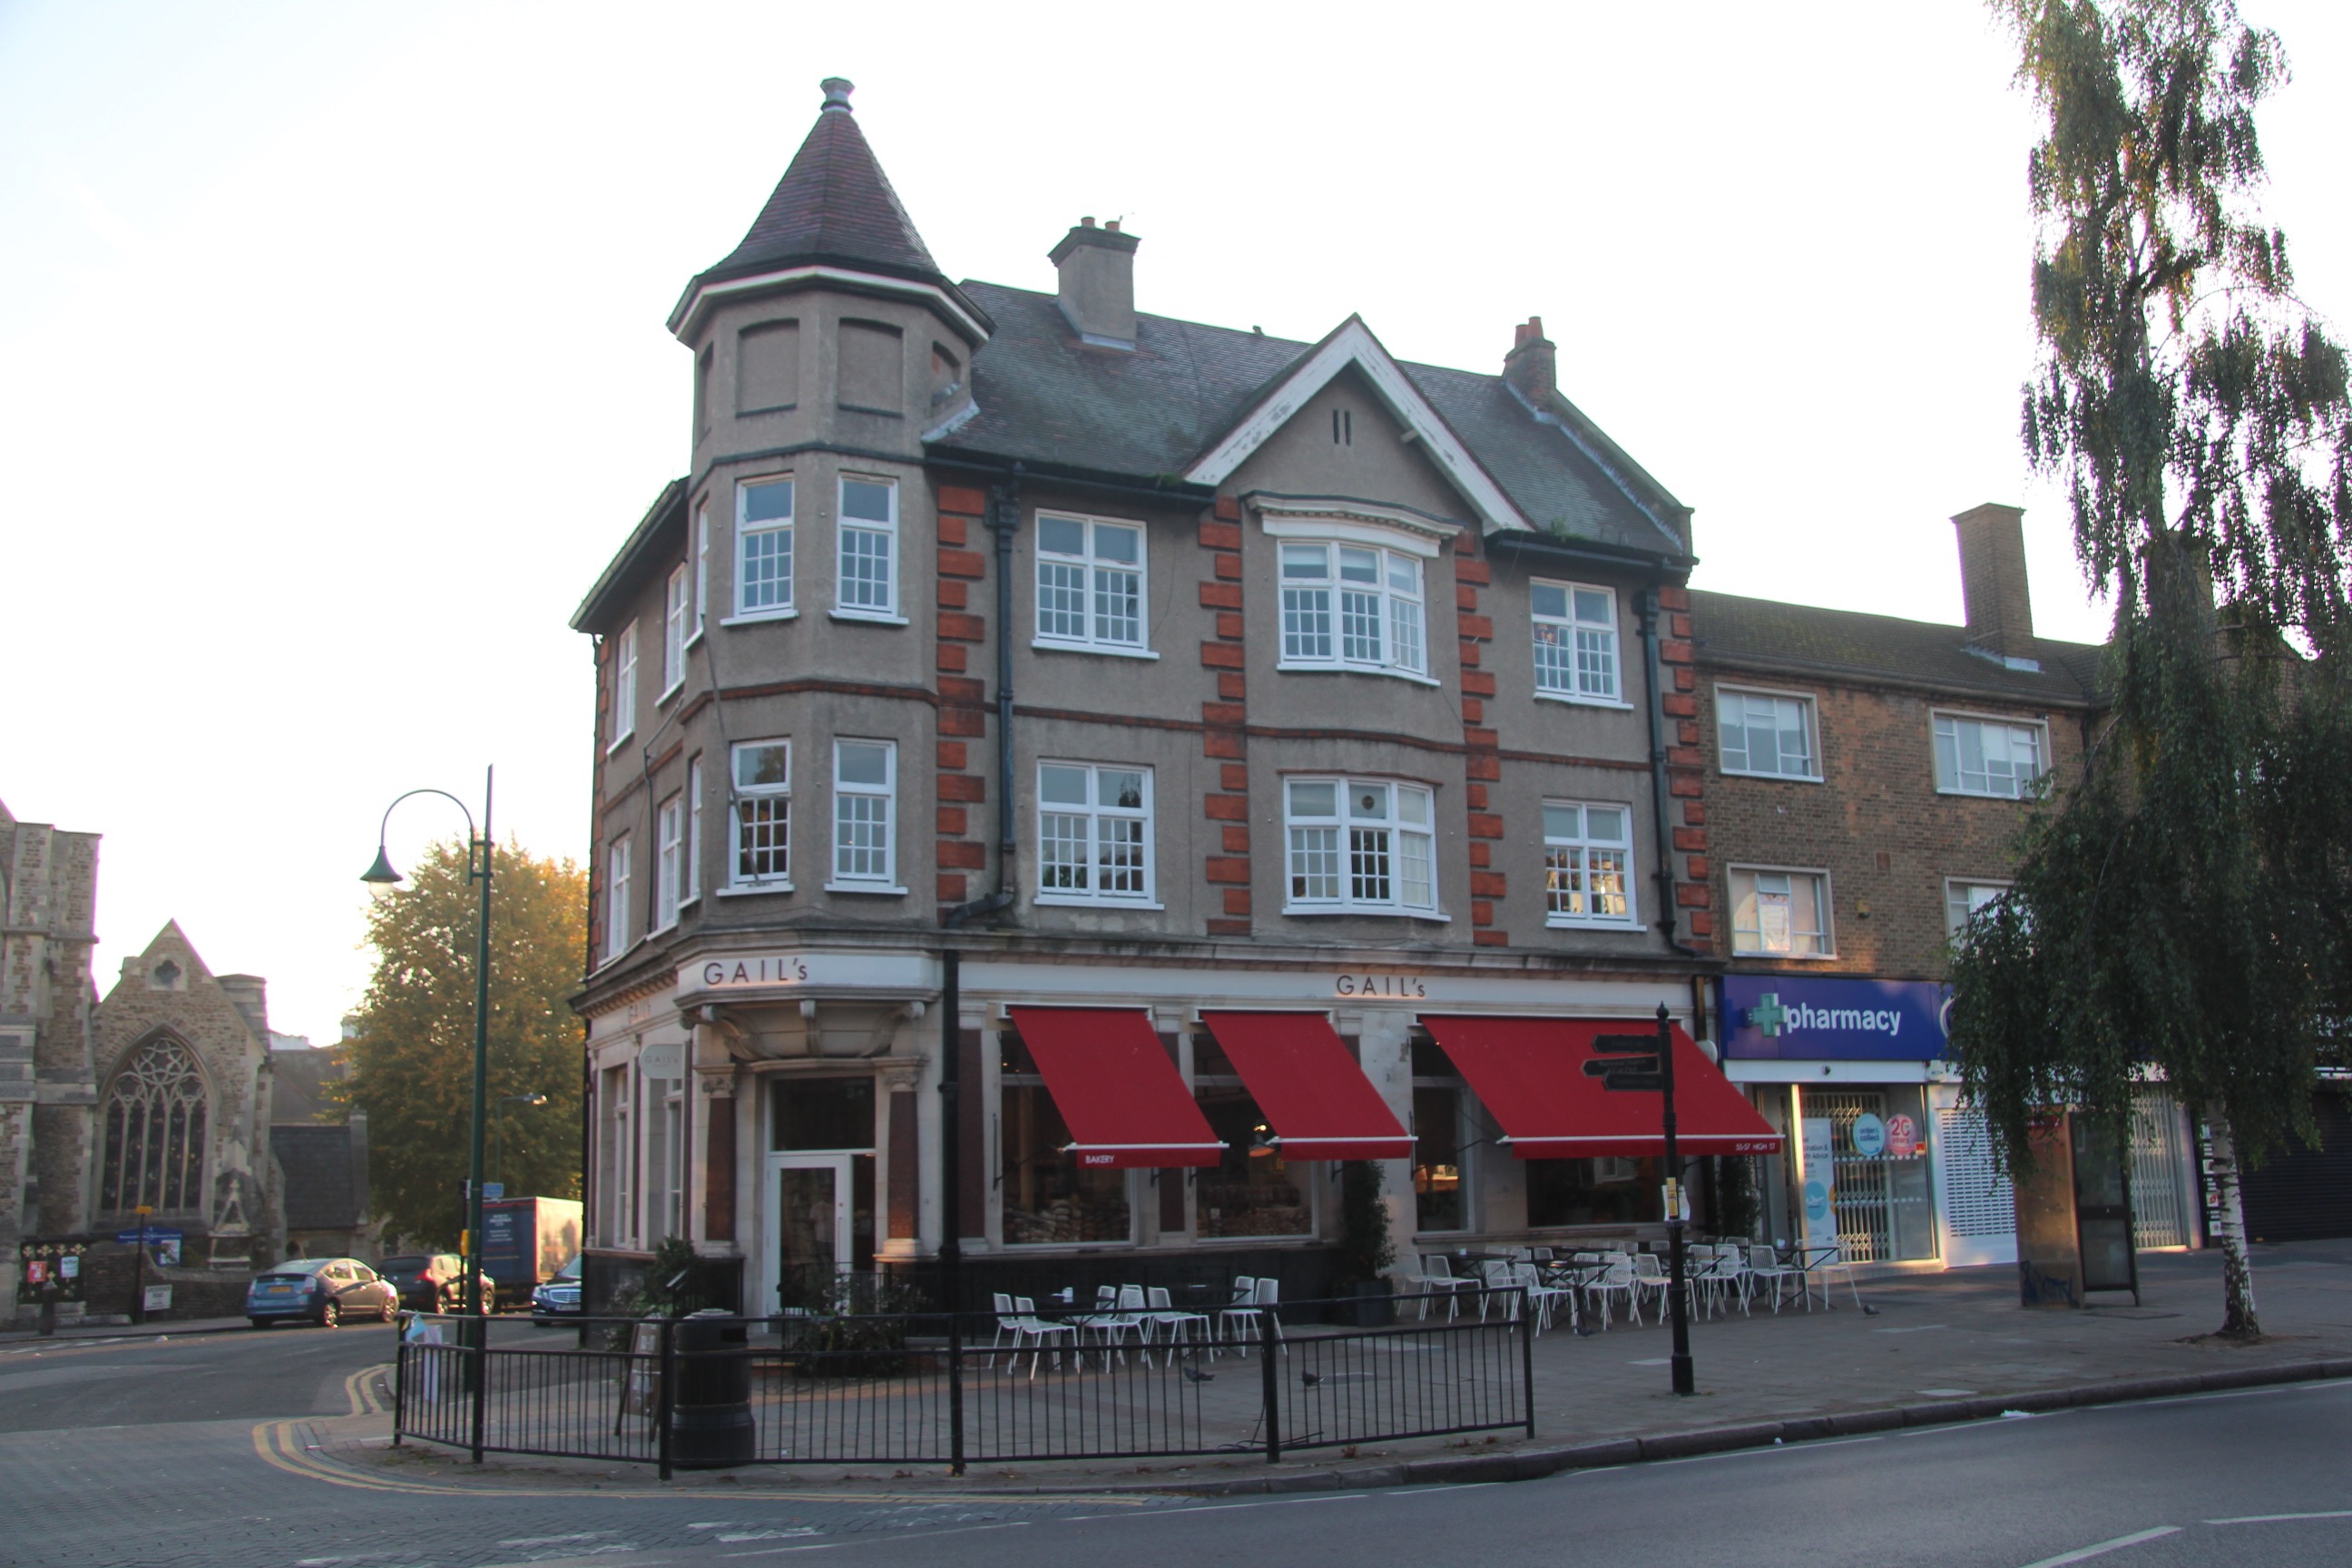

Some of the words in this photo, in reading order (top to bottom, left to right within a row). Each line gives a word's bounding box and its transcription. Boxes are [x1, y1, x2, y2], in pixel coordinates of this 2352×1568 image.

[703, 957, 808, 985] GAIL's
[1337, 975, 1426, 997] GAIL's
[1788, 1002, 1901, 1036] pharmacy
[1859, 1133, 1880, 1142] collect
[1085, 1154, 1115, 1164] BAKERY
